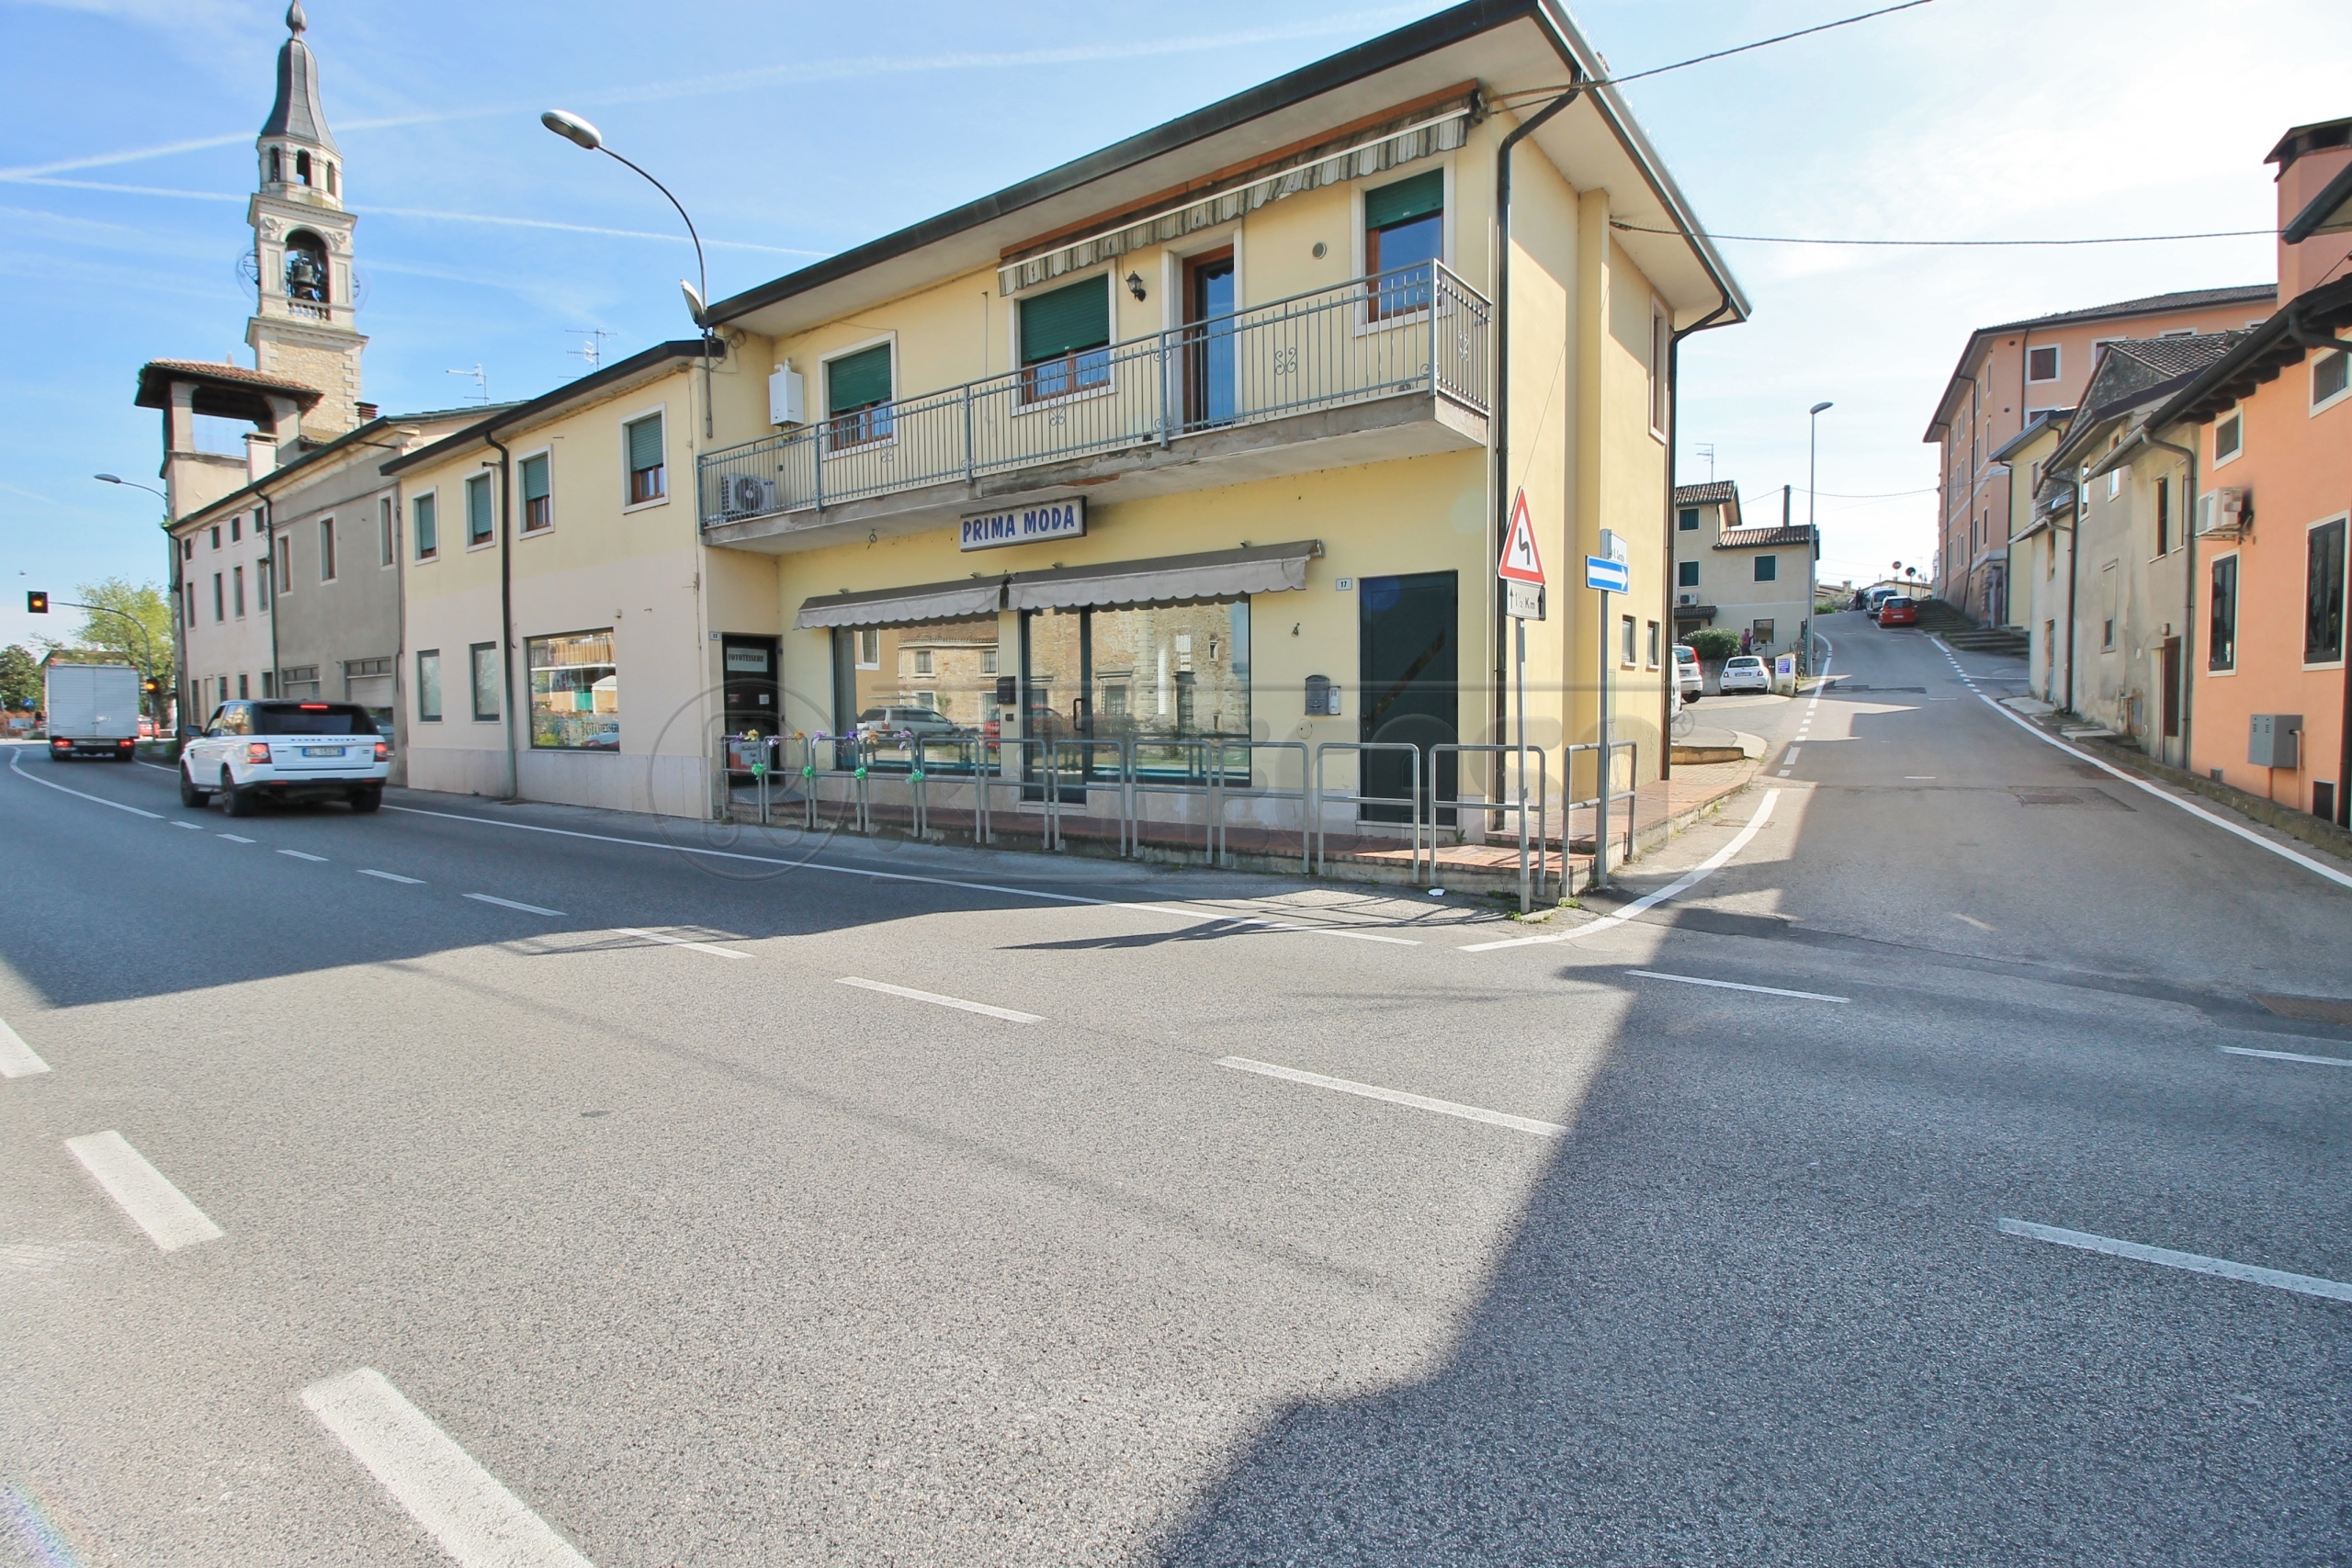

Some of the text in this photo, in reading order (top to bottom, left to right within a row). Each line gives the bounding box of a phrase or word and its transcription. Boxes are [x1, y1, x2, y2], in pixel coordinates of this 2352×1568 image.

[963, 505, 1075, 543] PRIMA MODA
[1524, 597, 1535, 610] Km
[728, 653, 764, 662] FOTOTESSERE
